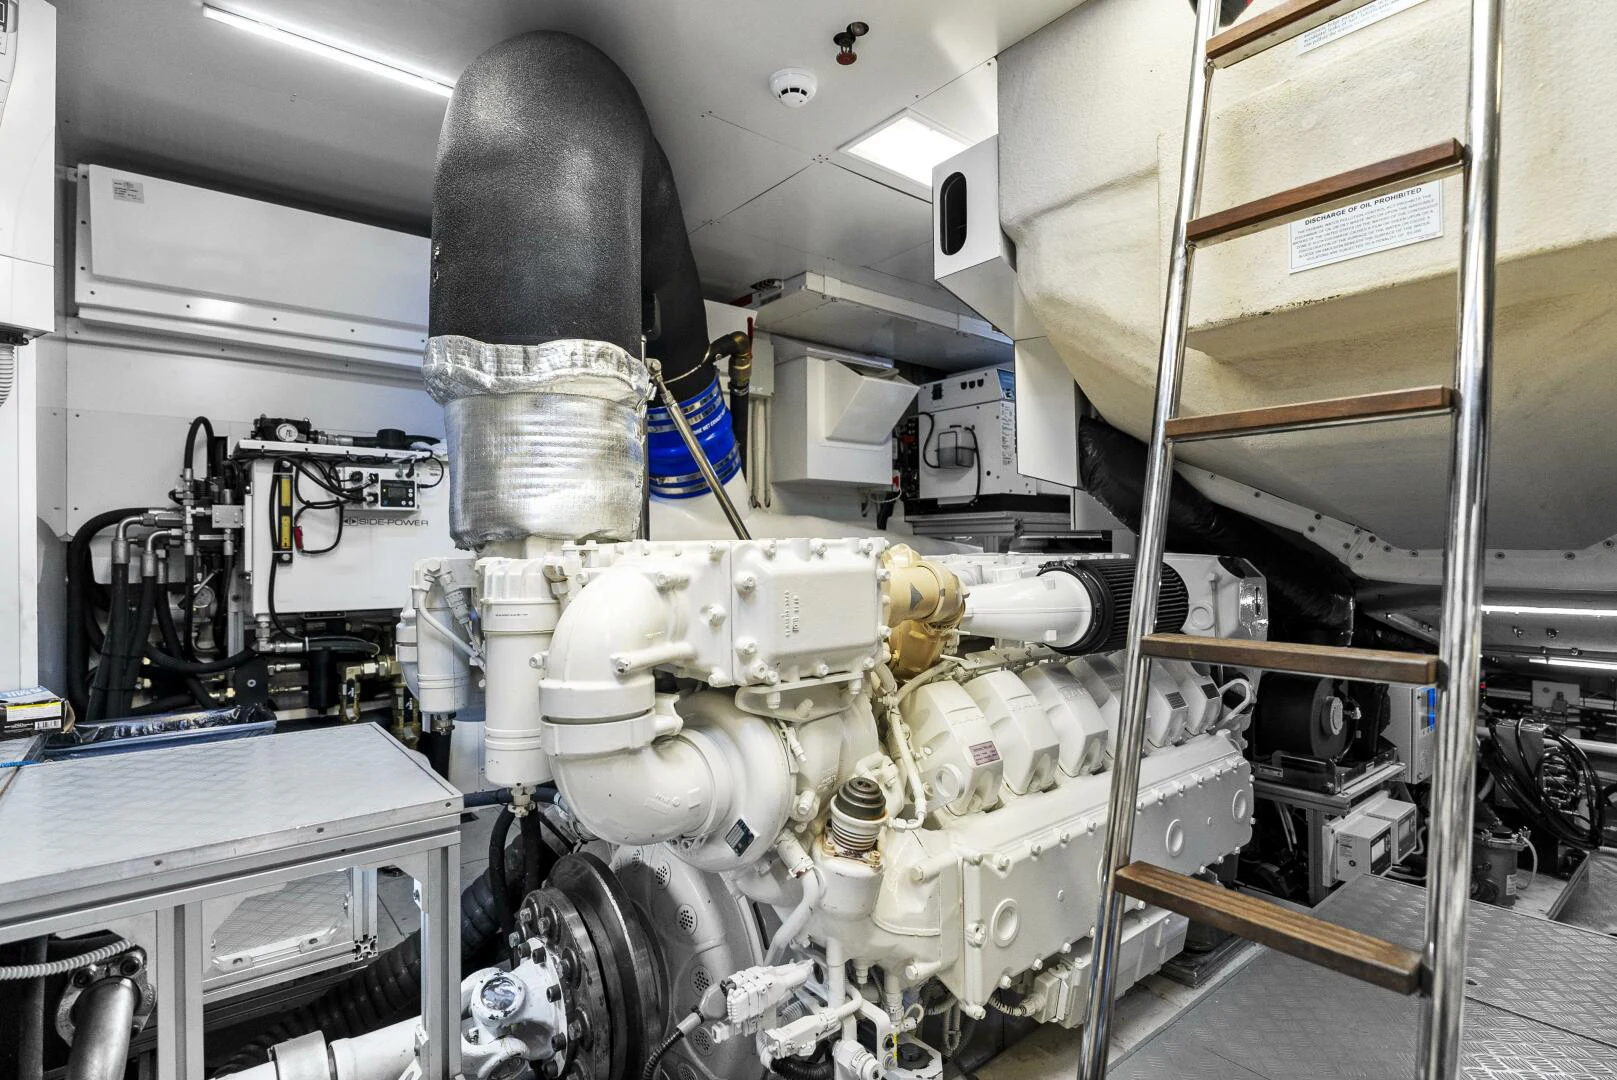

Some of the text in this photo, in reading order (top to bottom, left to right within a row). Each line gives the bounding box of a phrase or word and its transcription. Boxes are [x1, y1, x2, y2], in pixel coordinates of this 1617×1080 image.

[1305, 210, 1345, 225] DISCHARGE
[1375, 188, 1421, 205] PROHIBITED
[359, 518, 429, 526] SIDE-POWER
